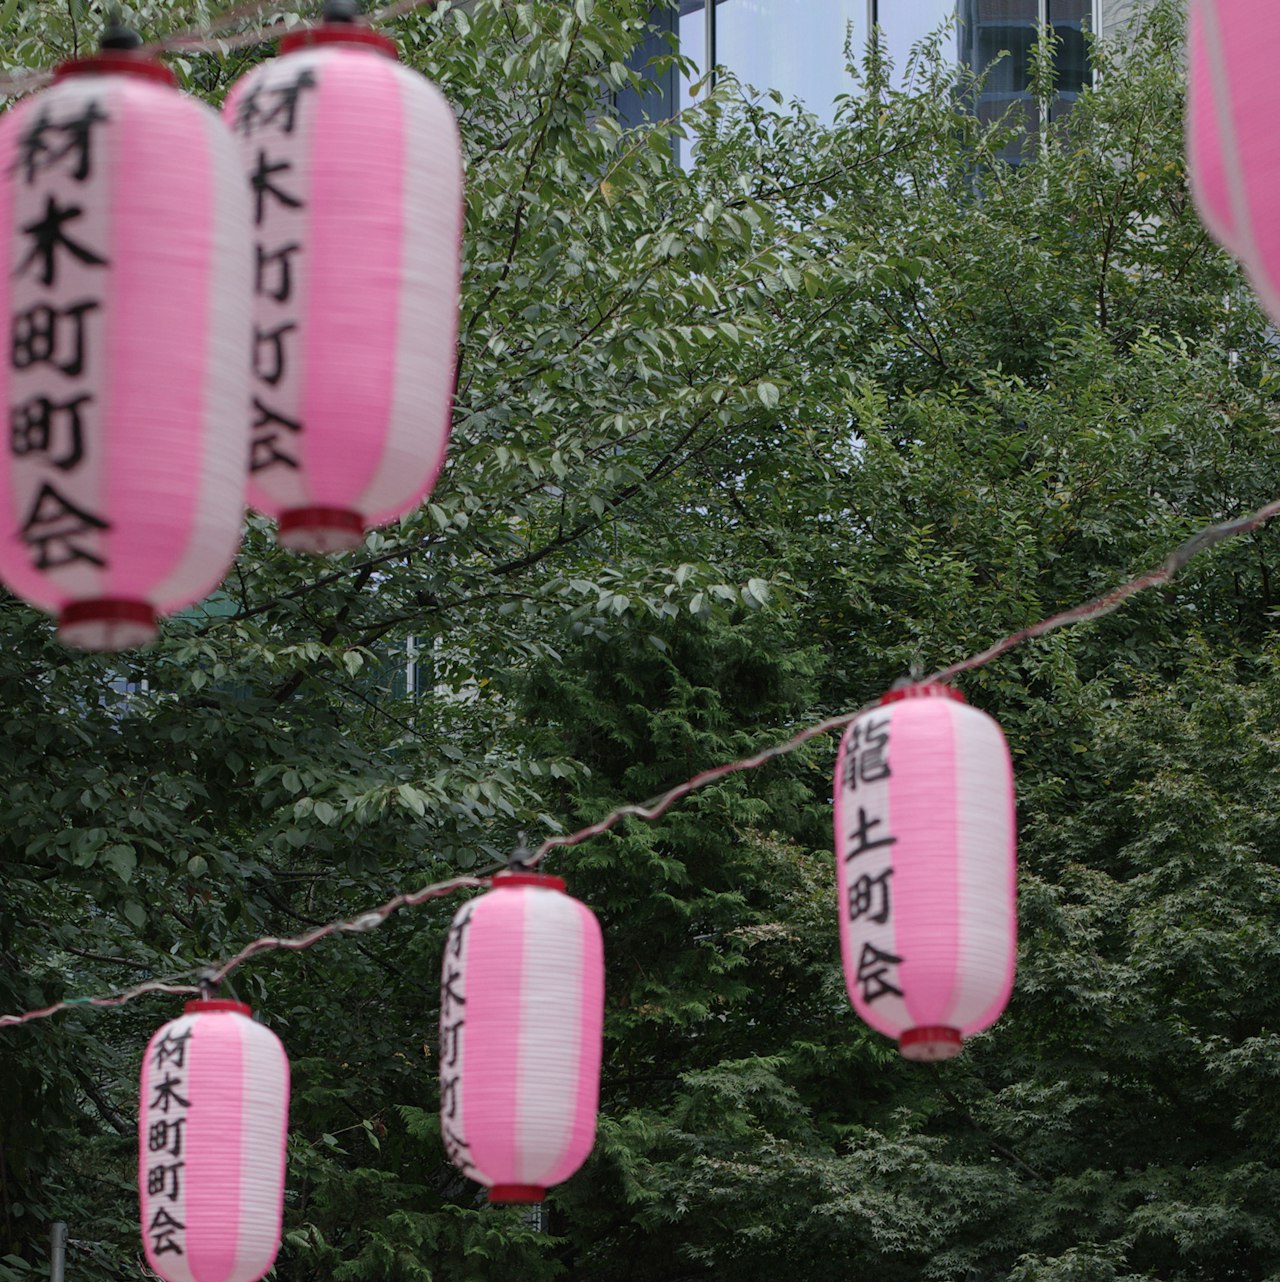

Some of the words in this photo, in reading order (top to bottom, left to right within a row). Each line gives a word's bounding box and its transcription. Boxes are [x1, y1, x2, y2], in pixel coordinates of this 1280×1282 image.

[8, 100, 112, 574] 材木町町会
[841, 718, 905, 1005] 龍土町会
[148, 1026, 193, 1257] 材木町町会
